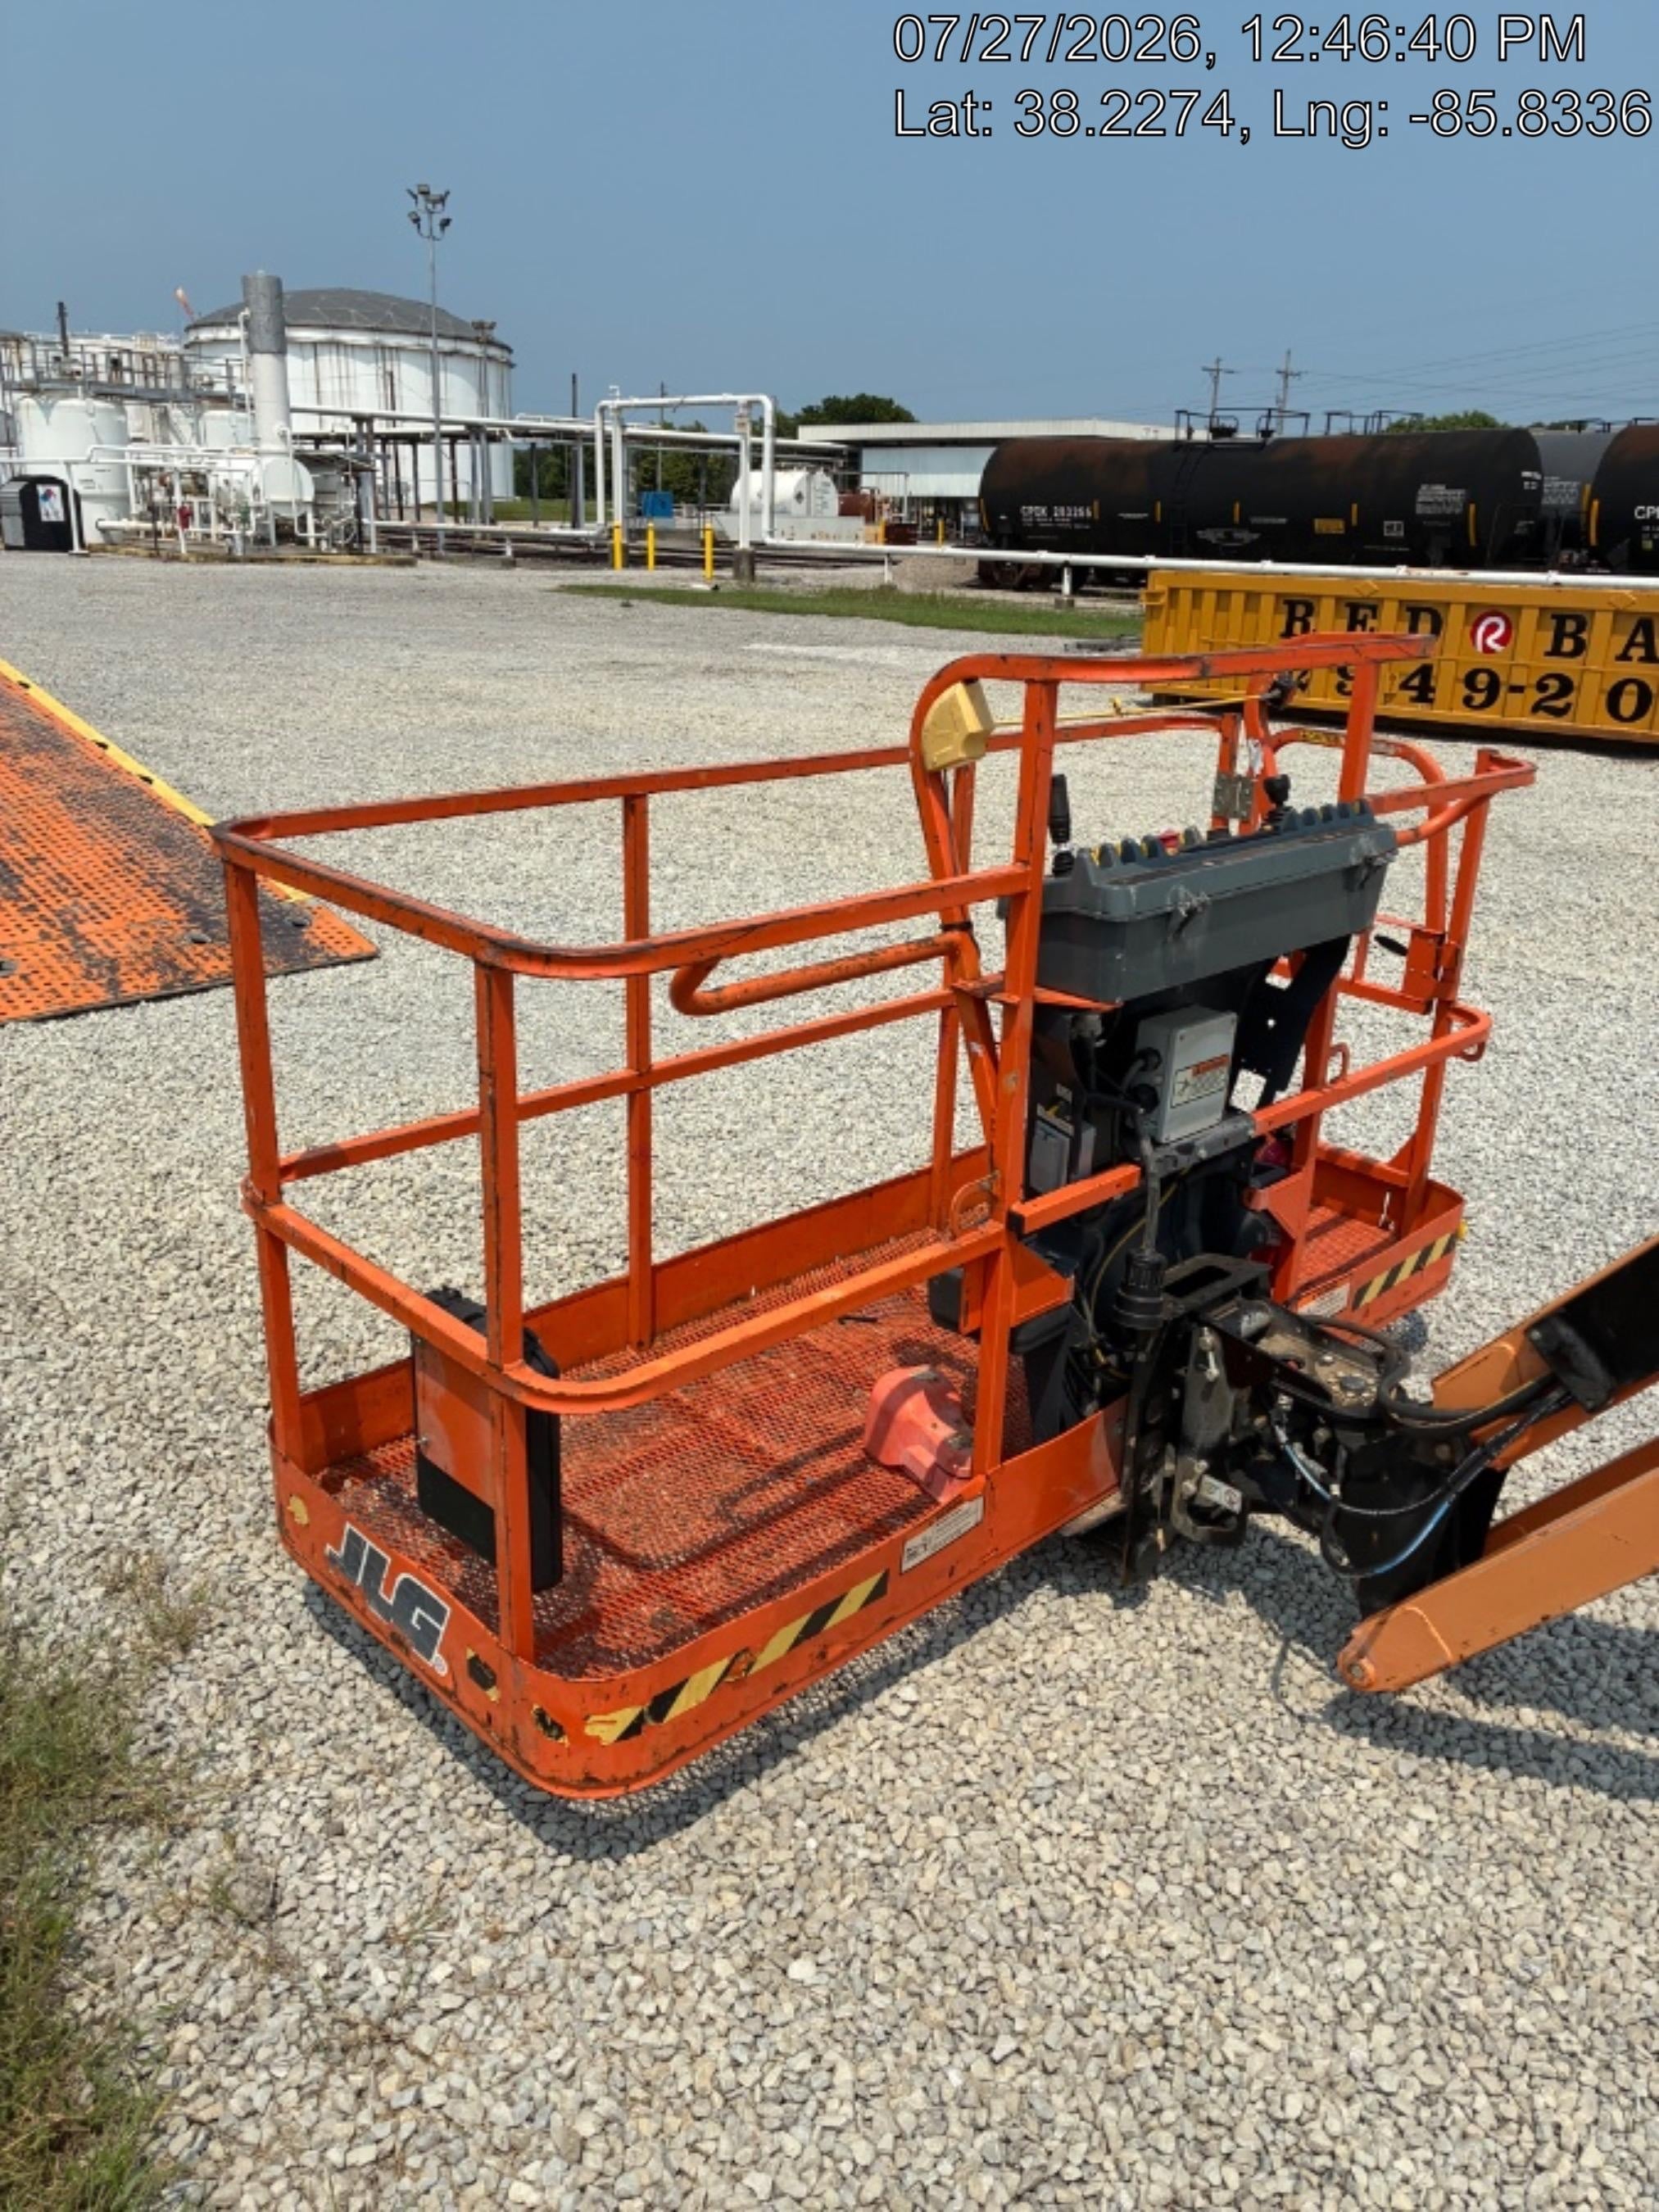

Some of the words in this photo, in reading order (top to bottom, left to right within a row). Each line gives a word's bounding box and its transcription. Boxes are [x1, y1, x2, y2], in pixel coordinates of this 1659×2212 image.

[1634, 505, 1659, 519] CP
[1280, 599, 1444, 637] RED
[324, 1521, 451, 1668] JLG
